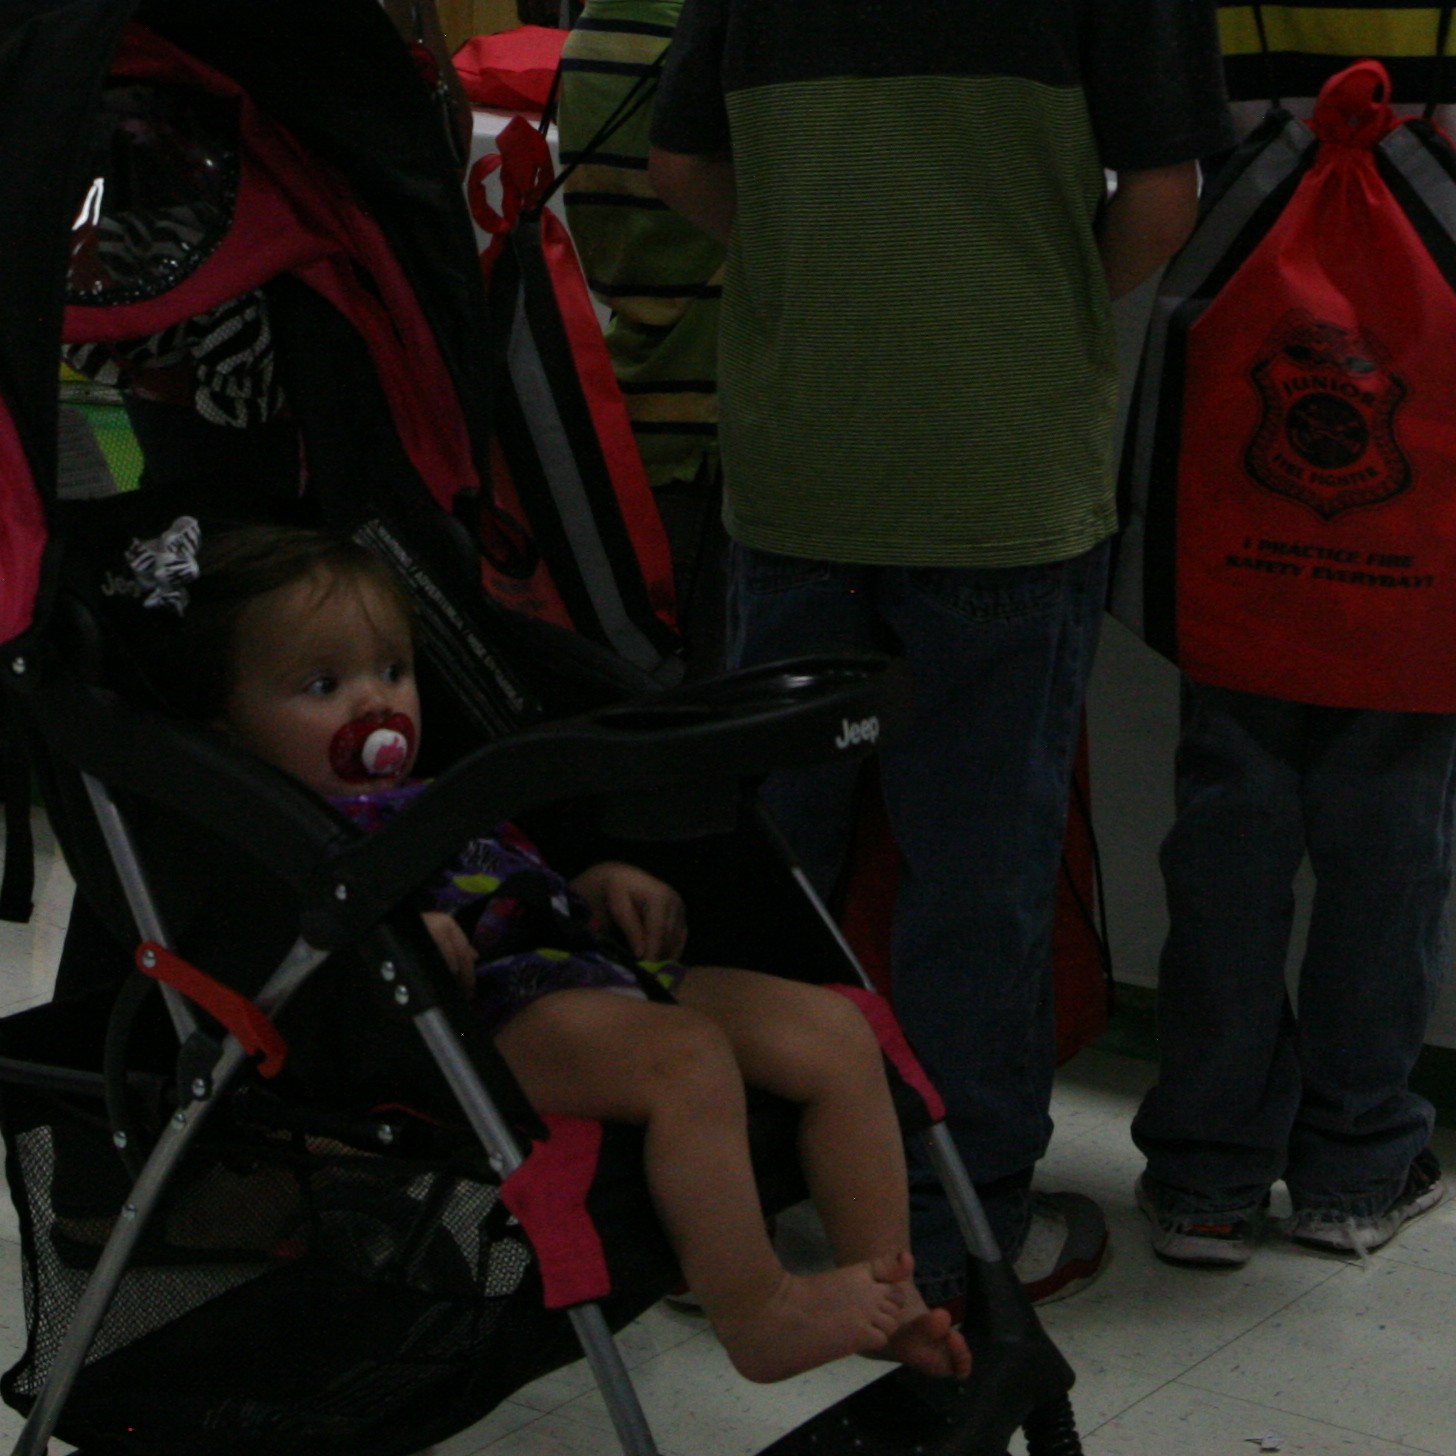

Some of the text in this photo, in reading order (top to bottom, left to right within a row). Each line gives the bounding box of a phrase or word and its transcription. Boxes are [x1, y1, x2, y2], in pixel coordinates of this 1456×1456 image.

[1225, 554, 1303, 577] SAFETY
[1259, 539, 1360, 564] PRACTICE
[1365, 552, 1415, 568] FIRE
[835, 715, 880, 750] Jeep
